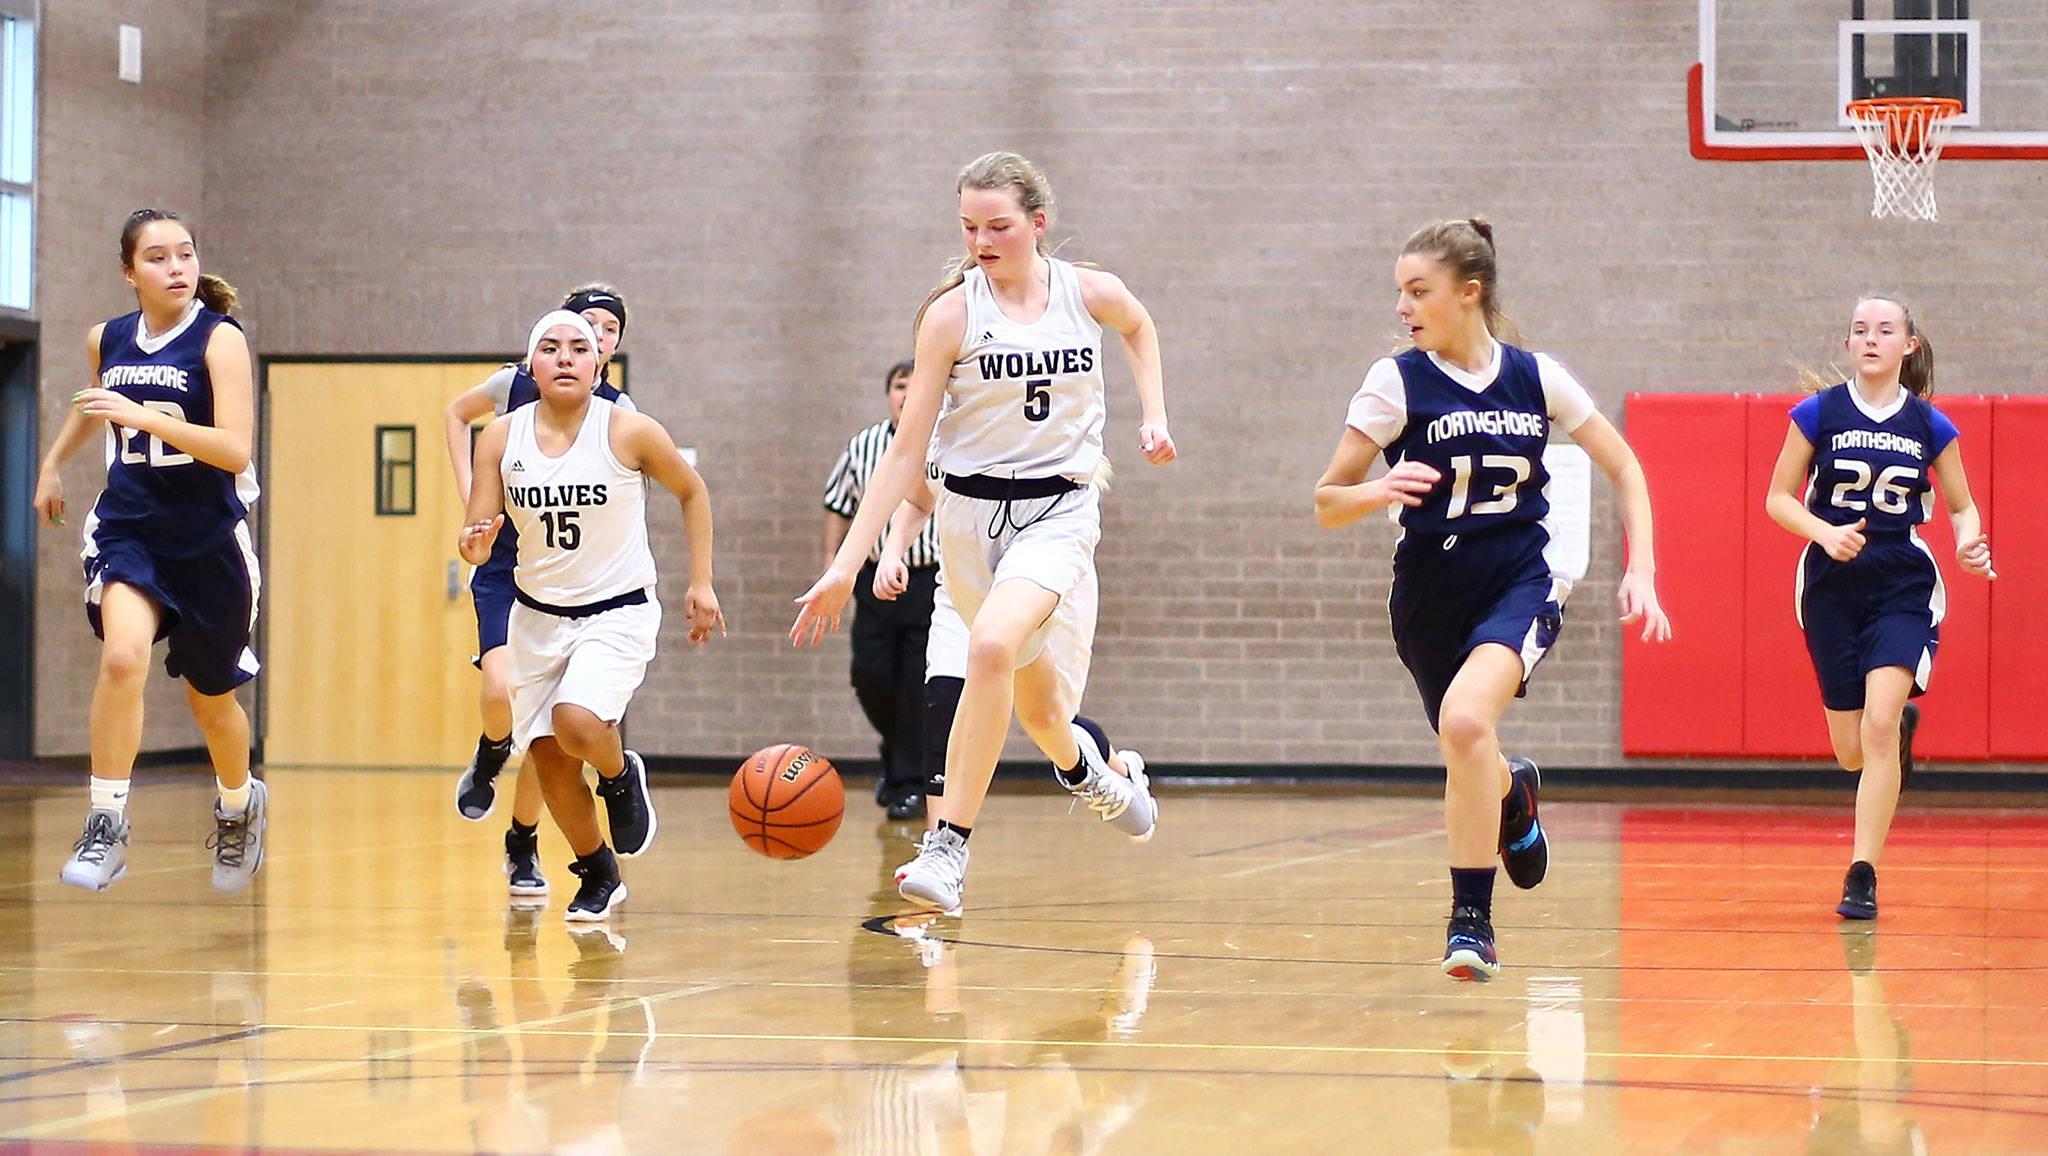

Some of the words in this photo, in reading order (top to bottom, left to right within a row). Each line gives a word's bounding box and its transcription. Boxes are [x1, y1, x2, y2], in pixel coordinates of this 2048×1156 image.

[979, 347, 1093, 380] WOLVES
[1024, 379, 1051, 422] 5
[1427, 409, 1543, 444] NORTHSHORE
[1831, 429, 1923, 460] NORTHSHORE
[508, 484, 608, 508] WOLVES
[1446, 455, 1531, 519] 13
[1831, 459, 1920, 514] 26
[539, 511, 581, 550] 15
